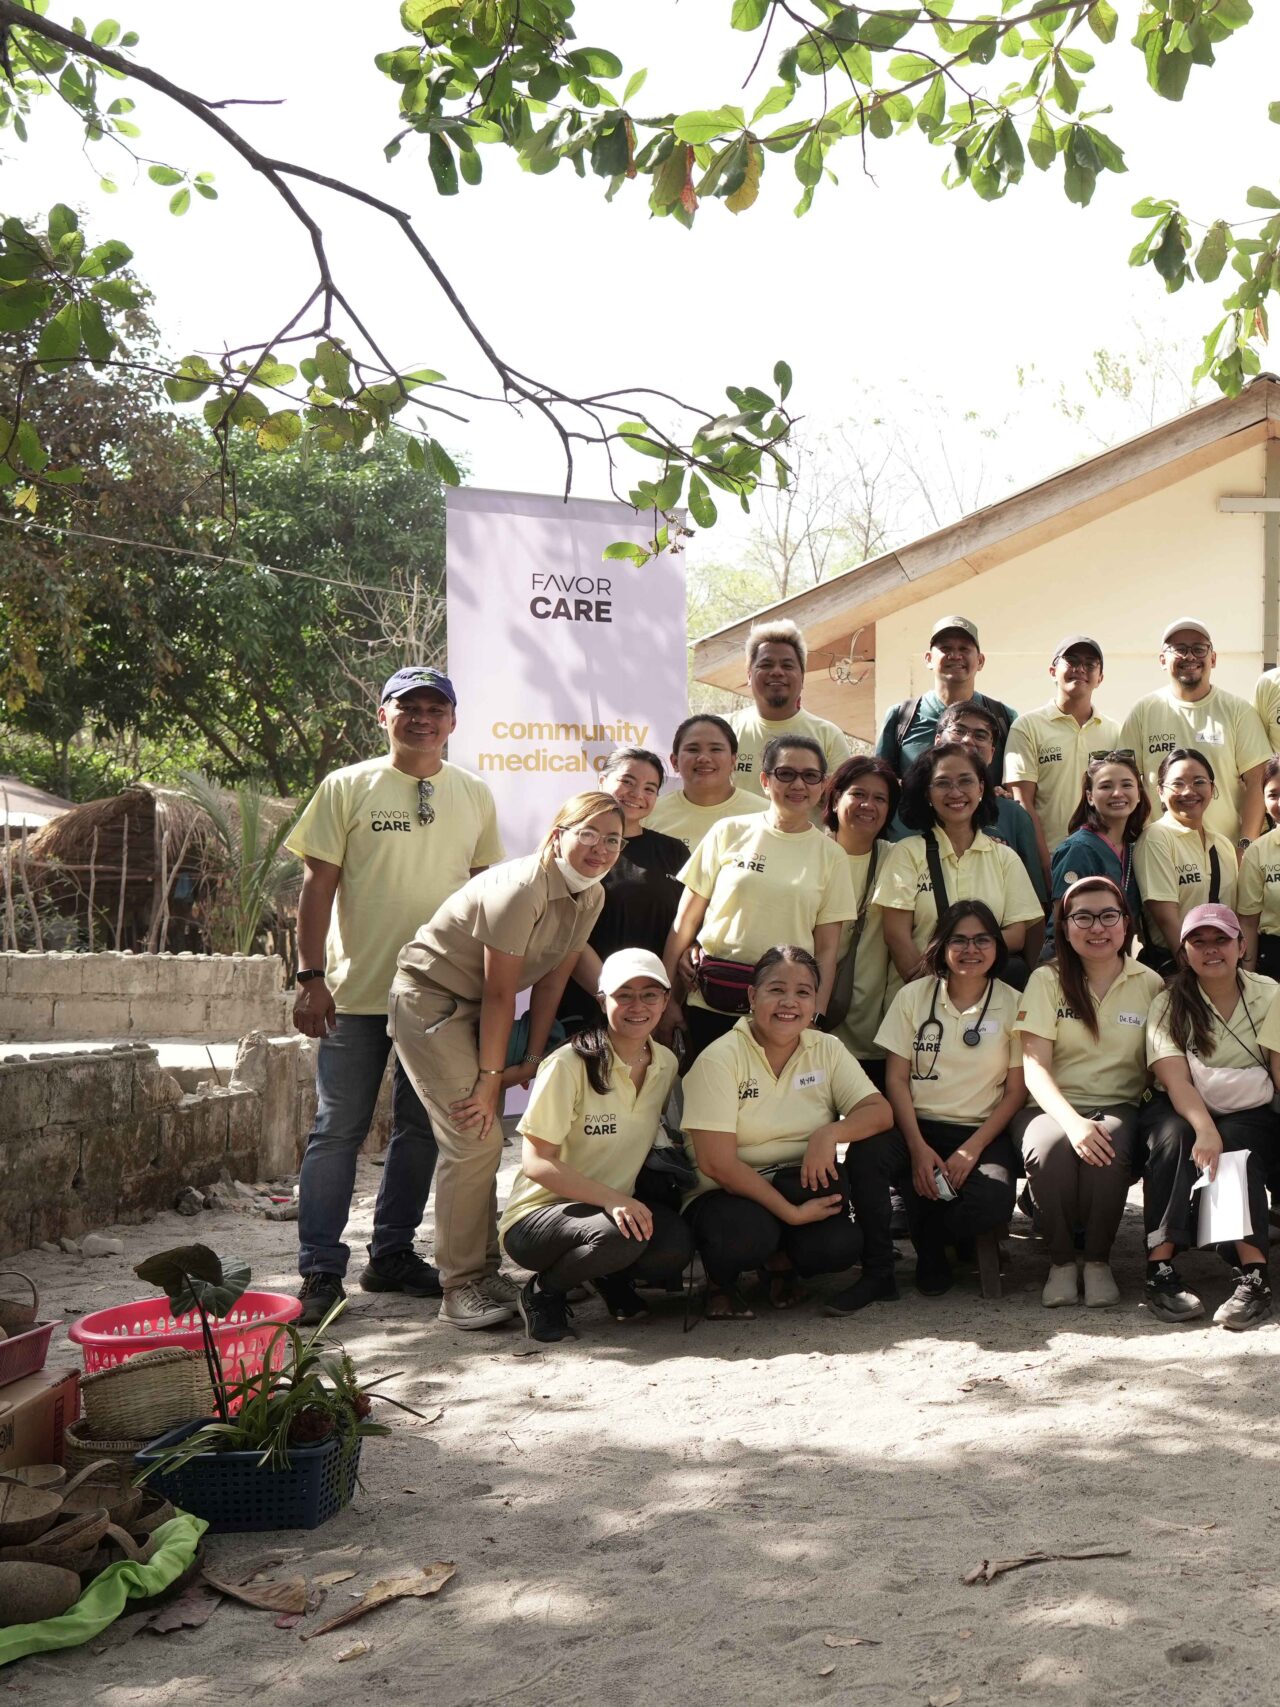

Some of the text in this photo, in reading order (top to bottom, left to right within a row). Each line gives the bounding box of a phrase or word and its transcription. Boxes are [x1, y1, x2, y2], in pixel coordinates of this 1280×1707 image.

[532, 573, 612, 596] FAVOR
[530, 596, 612, 623] CARE
[492, 719, 648, 746] community
[1149, 742, 1176, 754] CARE
[478, 748, 587, 772] medical
[1038, 753, 1063, 764] CARE
[370, 811, 410, 820] FAVOR
[371, 820, 411, 832] CARE
[1178, 872, 1202, 886] ARE
[584, 1114, 617, 1123] FAVOR
[584, 1124, 617, 1136] CARE
